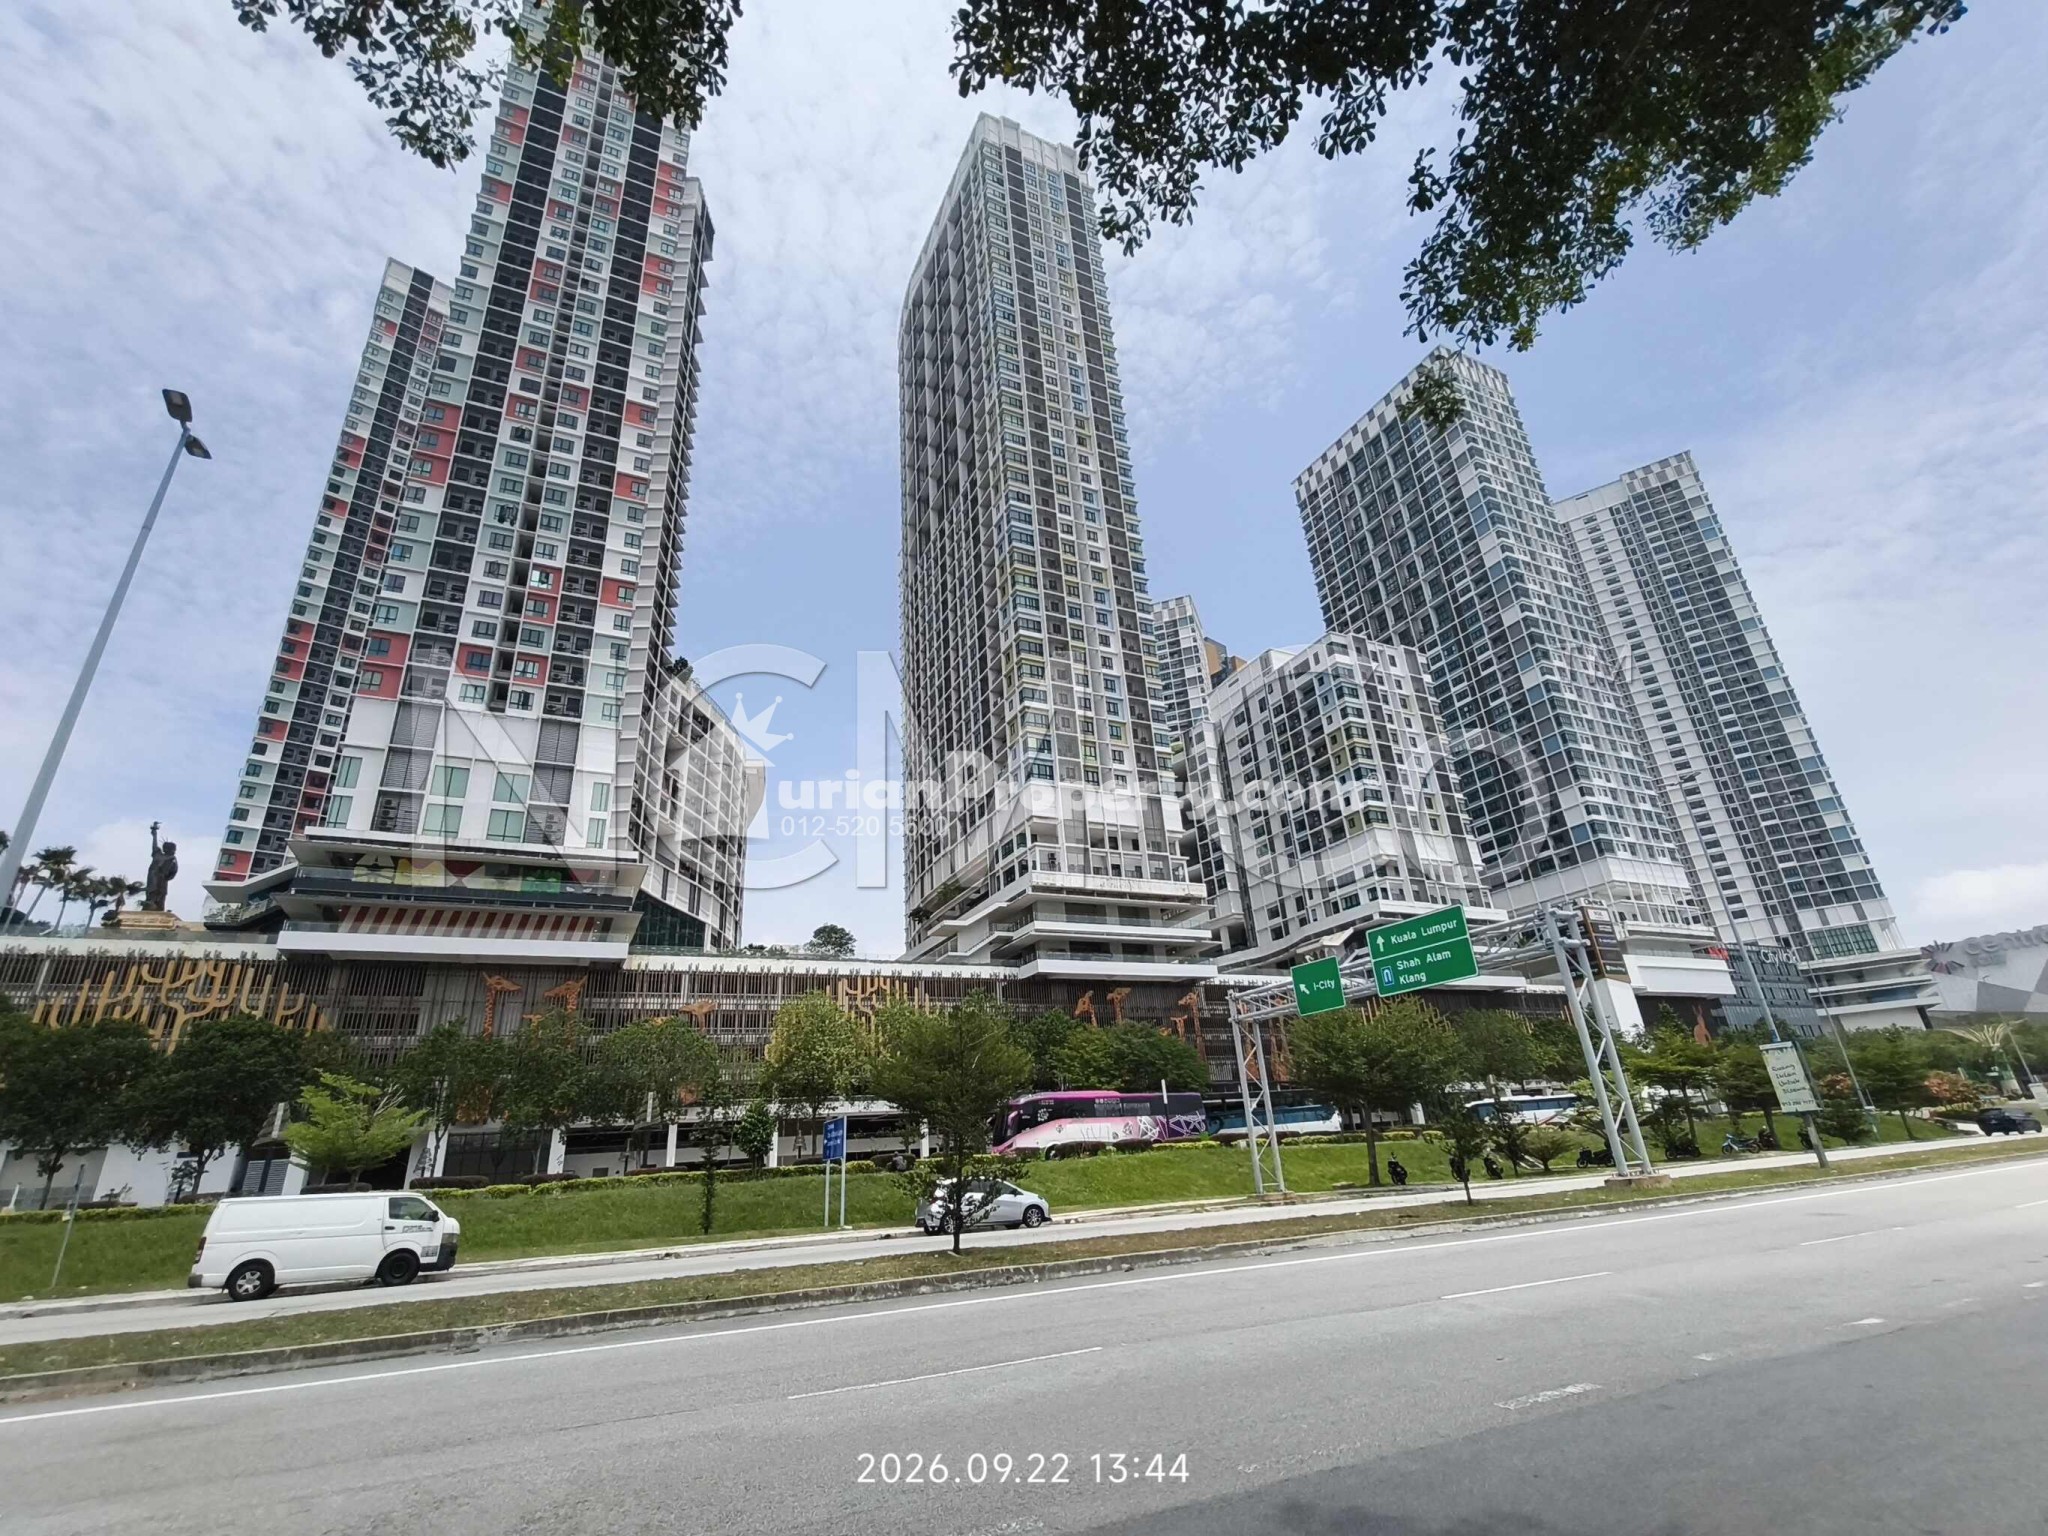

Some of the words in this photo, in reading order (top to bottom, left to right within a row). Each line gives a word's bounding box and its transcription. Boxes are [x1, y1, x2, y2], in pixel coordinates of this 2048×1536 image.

[1390, 931, 1417, 945] Kuala
[1420, 920, 1458, 937] Lumpur
[1396, 957, 1421, 970] Shah
[1426, 951, 1452, 963] Alam
[1399, 972, 1427, 985] Klang
